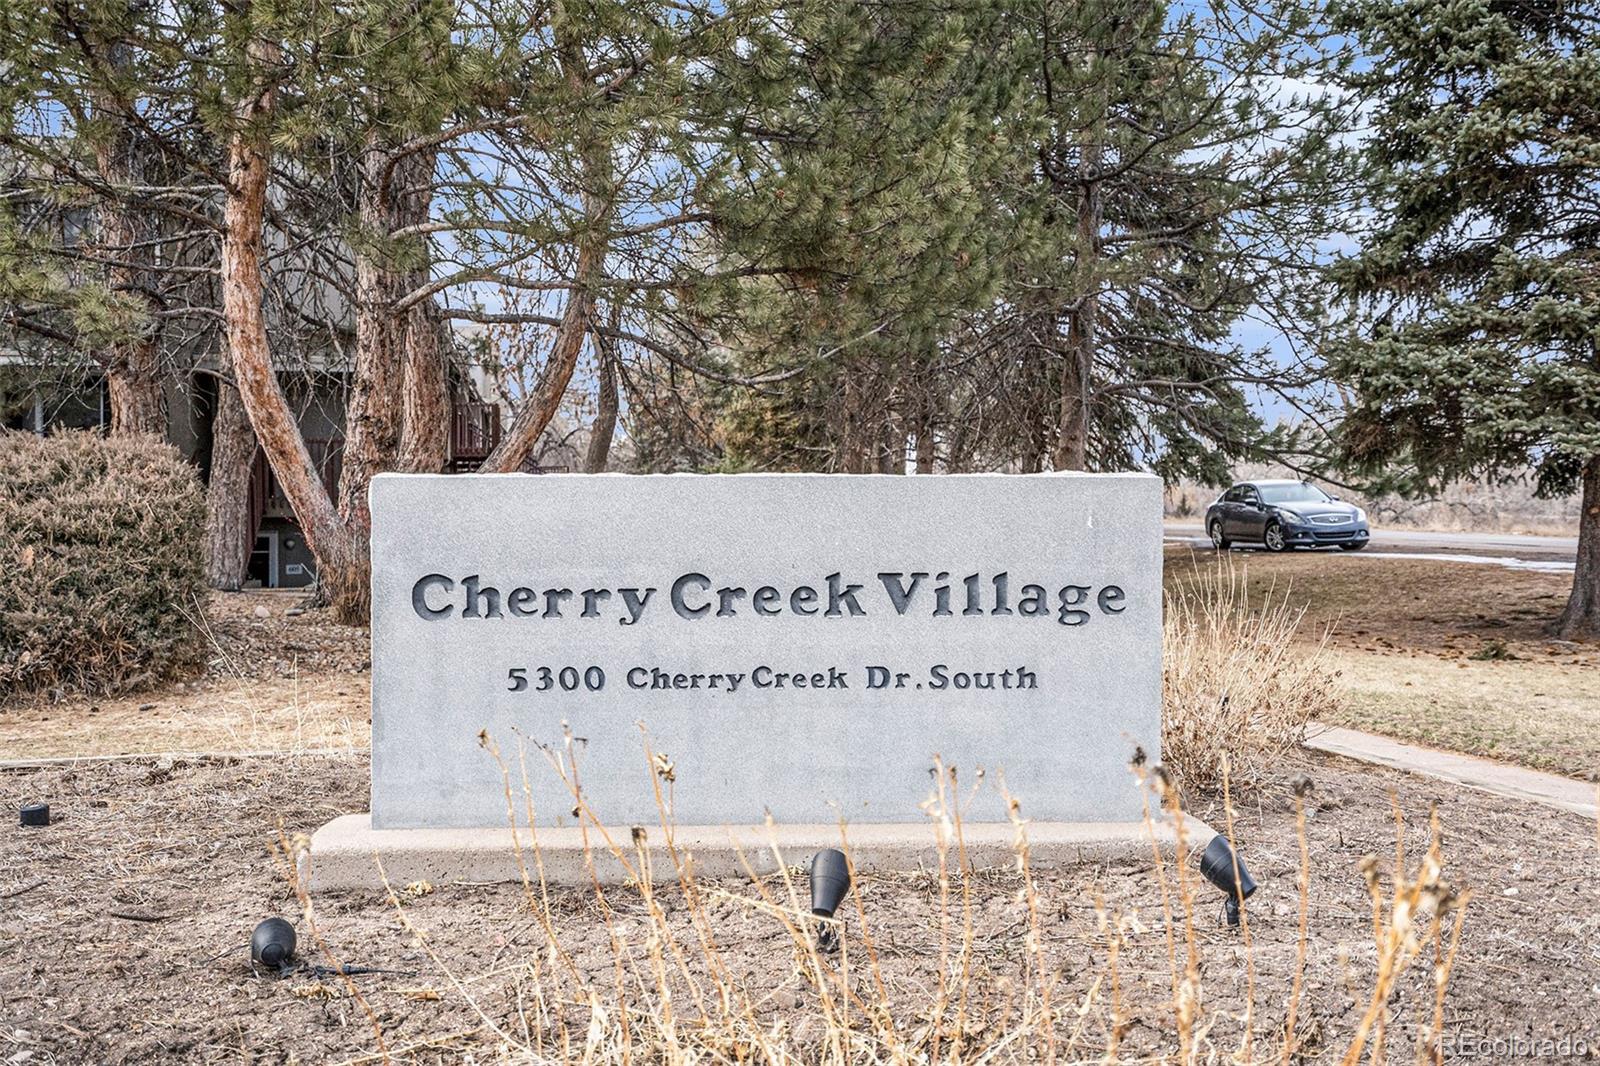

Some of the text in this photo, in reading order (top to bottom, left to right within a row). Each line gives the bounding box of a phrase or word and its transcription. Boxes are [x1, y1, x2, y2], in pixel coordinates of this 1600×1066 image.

[412, 571, 1125, 627] Cherry Creek Village
[508, 666, 606, 692] 5300
